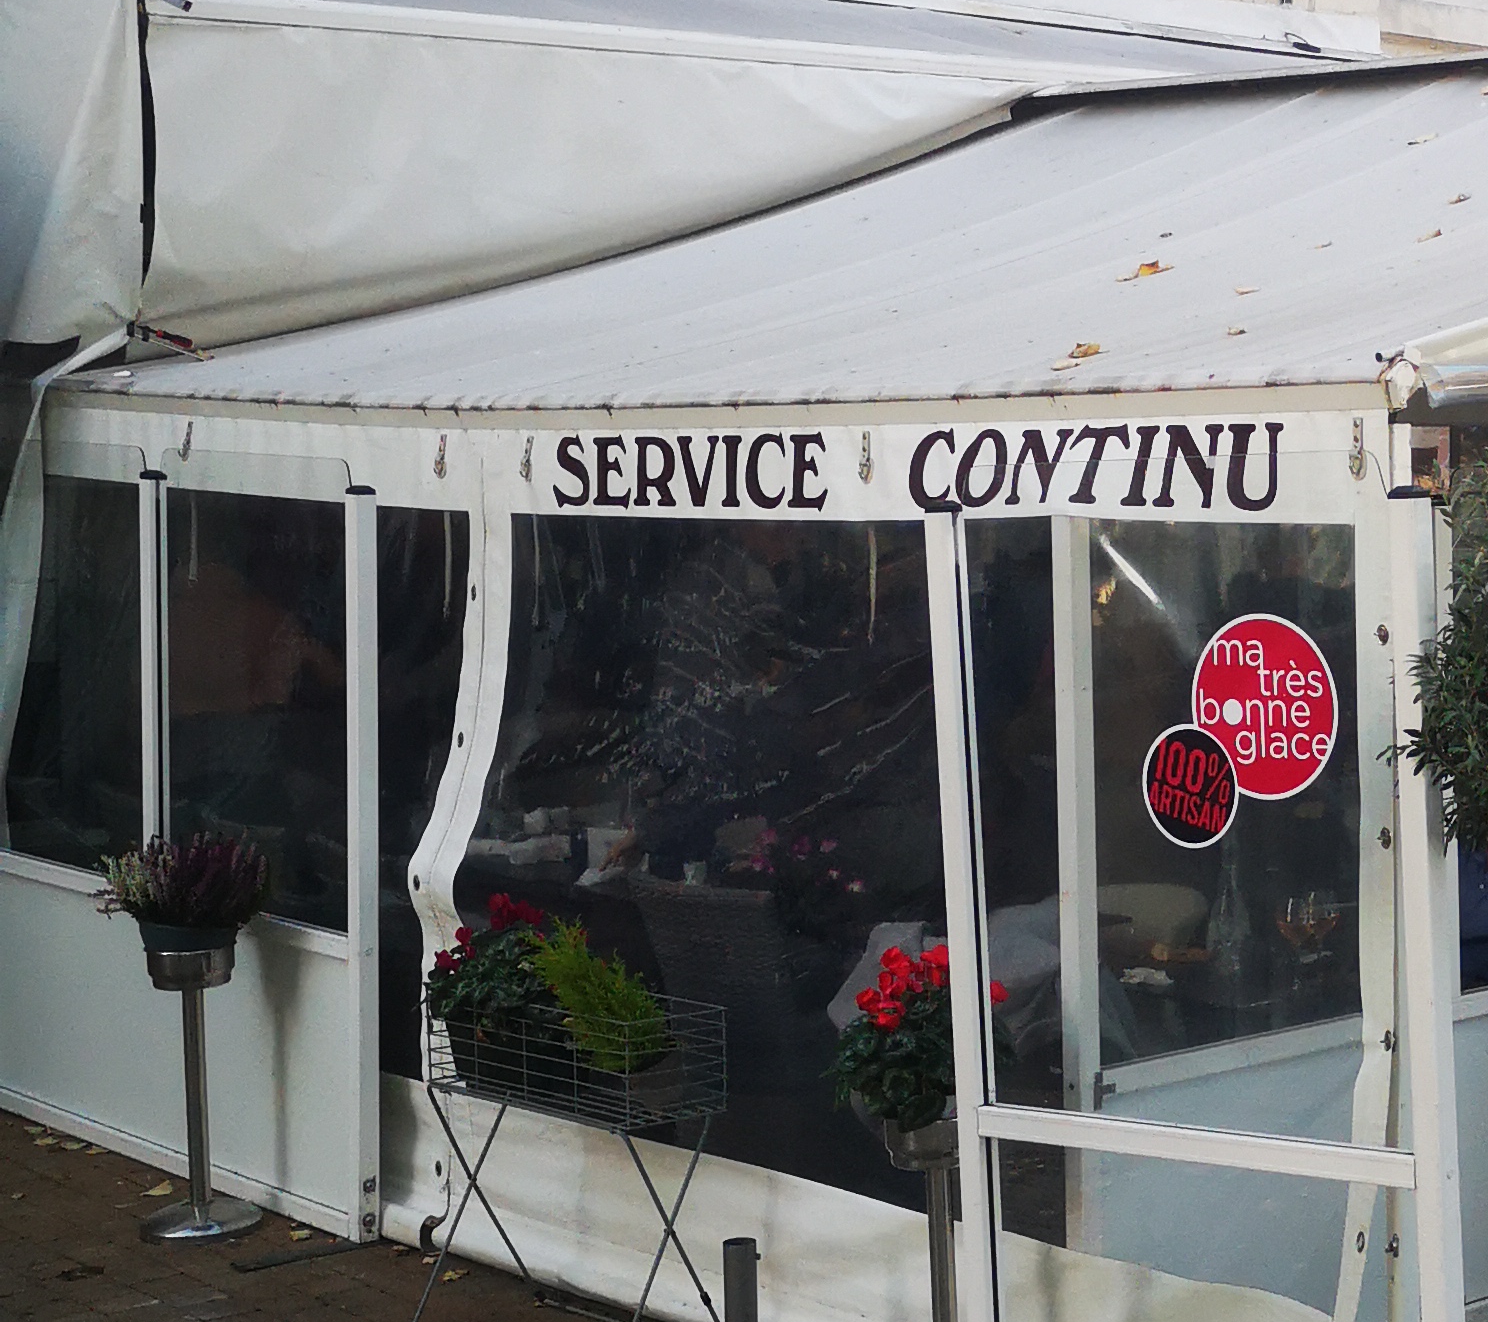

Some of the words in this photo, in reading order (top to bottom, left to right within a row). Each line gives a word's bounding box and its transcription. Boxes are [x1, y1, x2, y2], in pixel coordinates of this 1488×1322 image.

[551, 430, 829, 512] SERVICE
[908, 421, 1285, 512] CONTINU
[1212, 639, 1265, 667] ma
[1256, 659, 1324, 699] très
[1198, 688, 1311, 728] bonne
[1234, 730, 1330, 765] glace
[1154, 738, 1231, 804] 100%
[1149, 780, 1228, 834] ARTISAN
